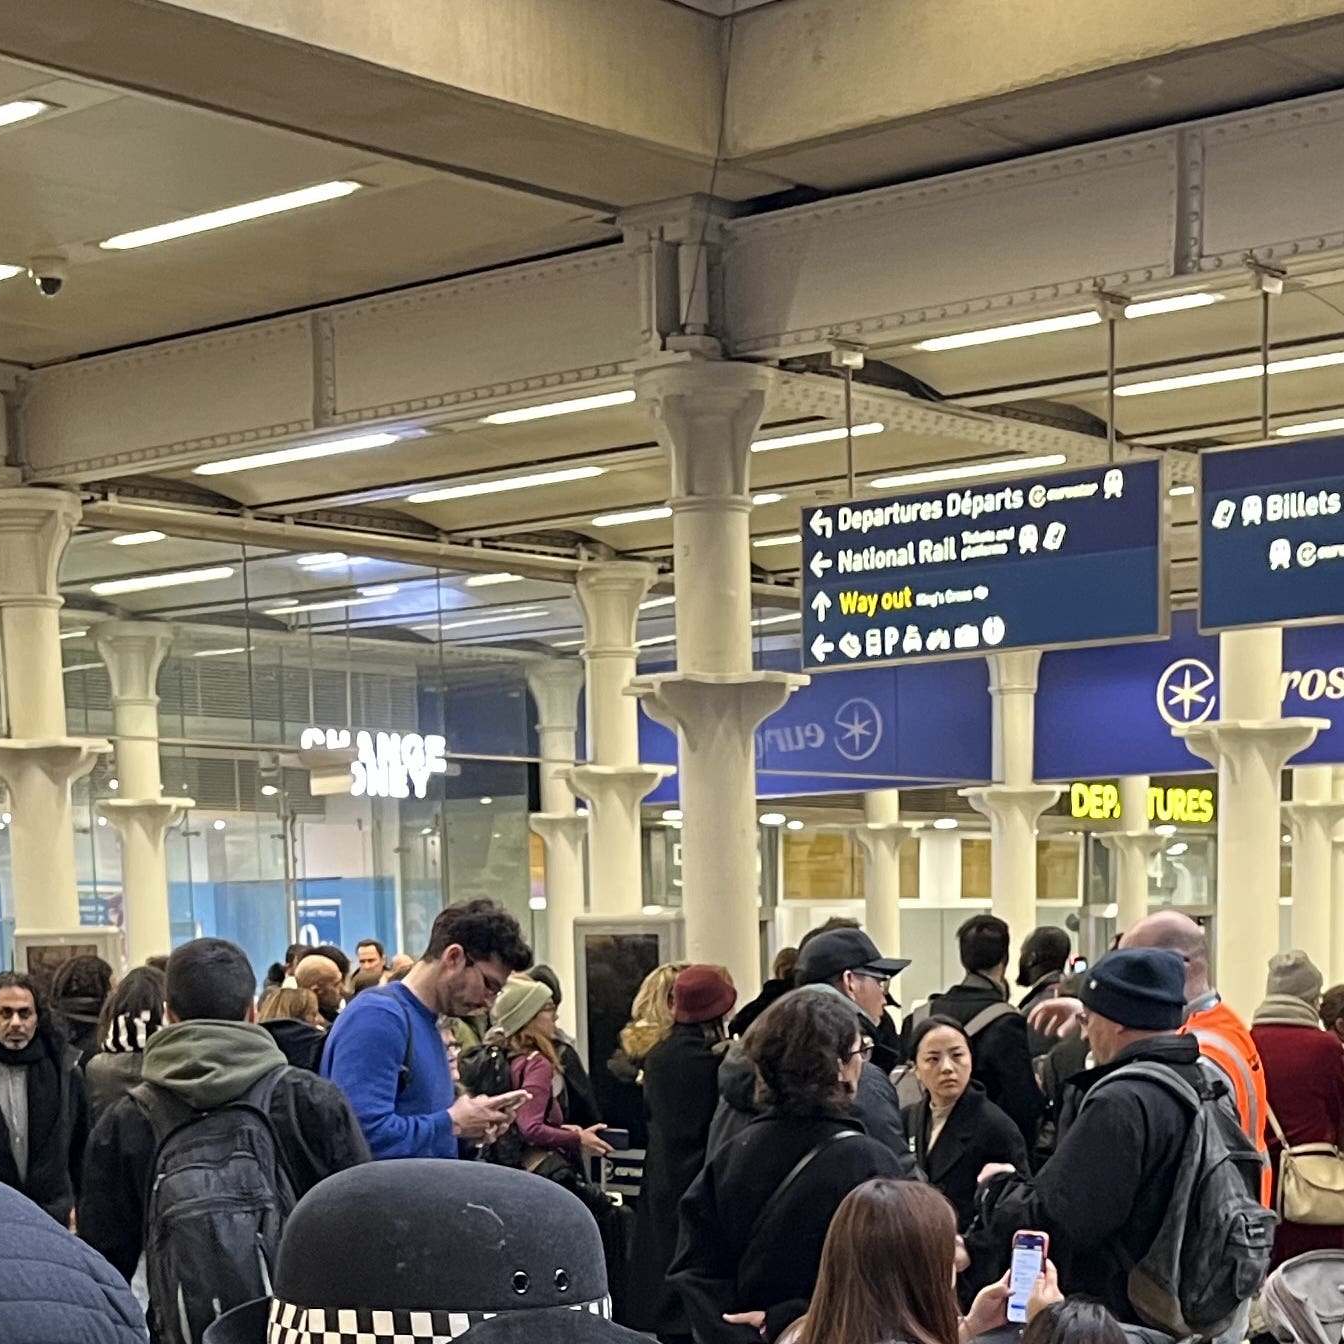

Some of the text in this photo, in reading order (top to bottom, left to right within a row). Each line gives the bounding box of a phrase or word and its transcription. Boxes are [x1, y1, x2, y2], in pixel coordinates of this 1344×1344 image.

[838, 498, 944, 534] Departures
[946, 487, 1024, 519] Départs
[1266, 488, 1342, 521] Billets
[837, 536, 957, 576] National Rail
[839, 590, 879, 618] Way
[881, 586, 912, 611] out
